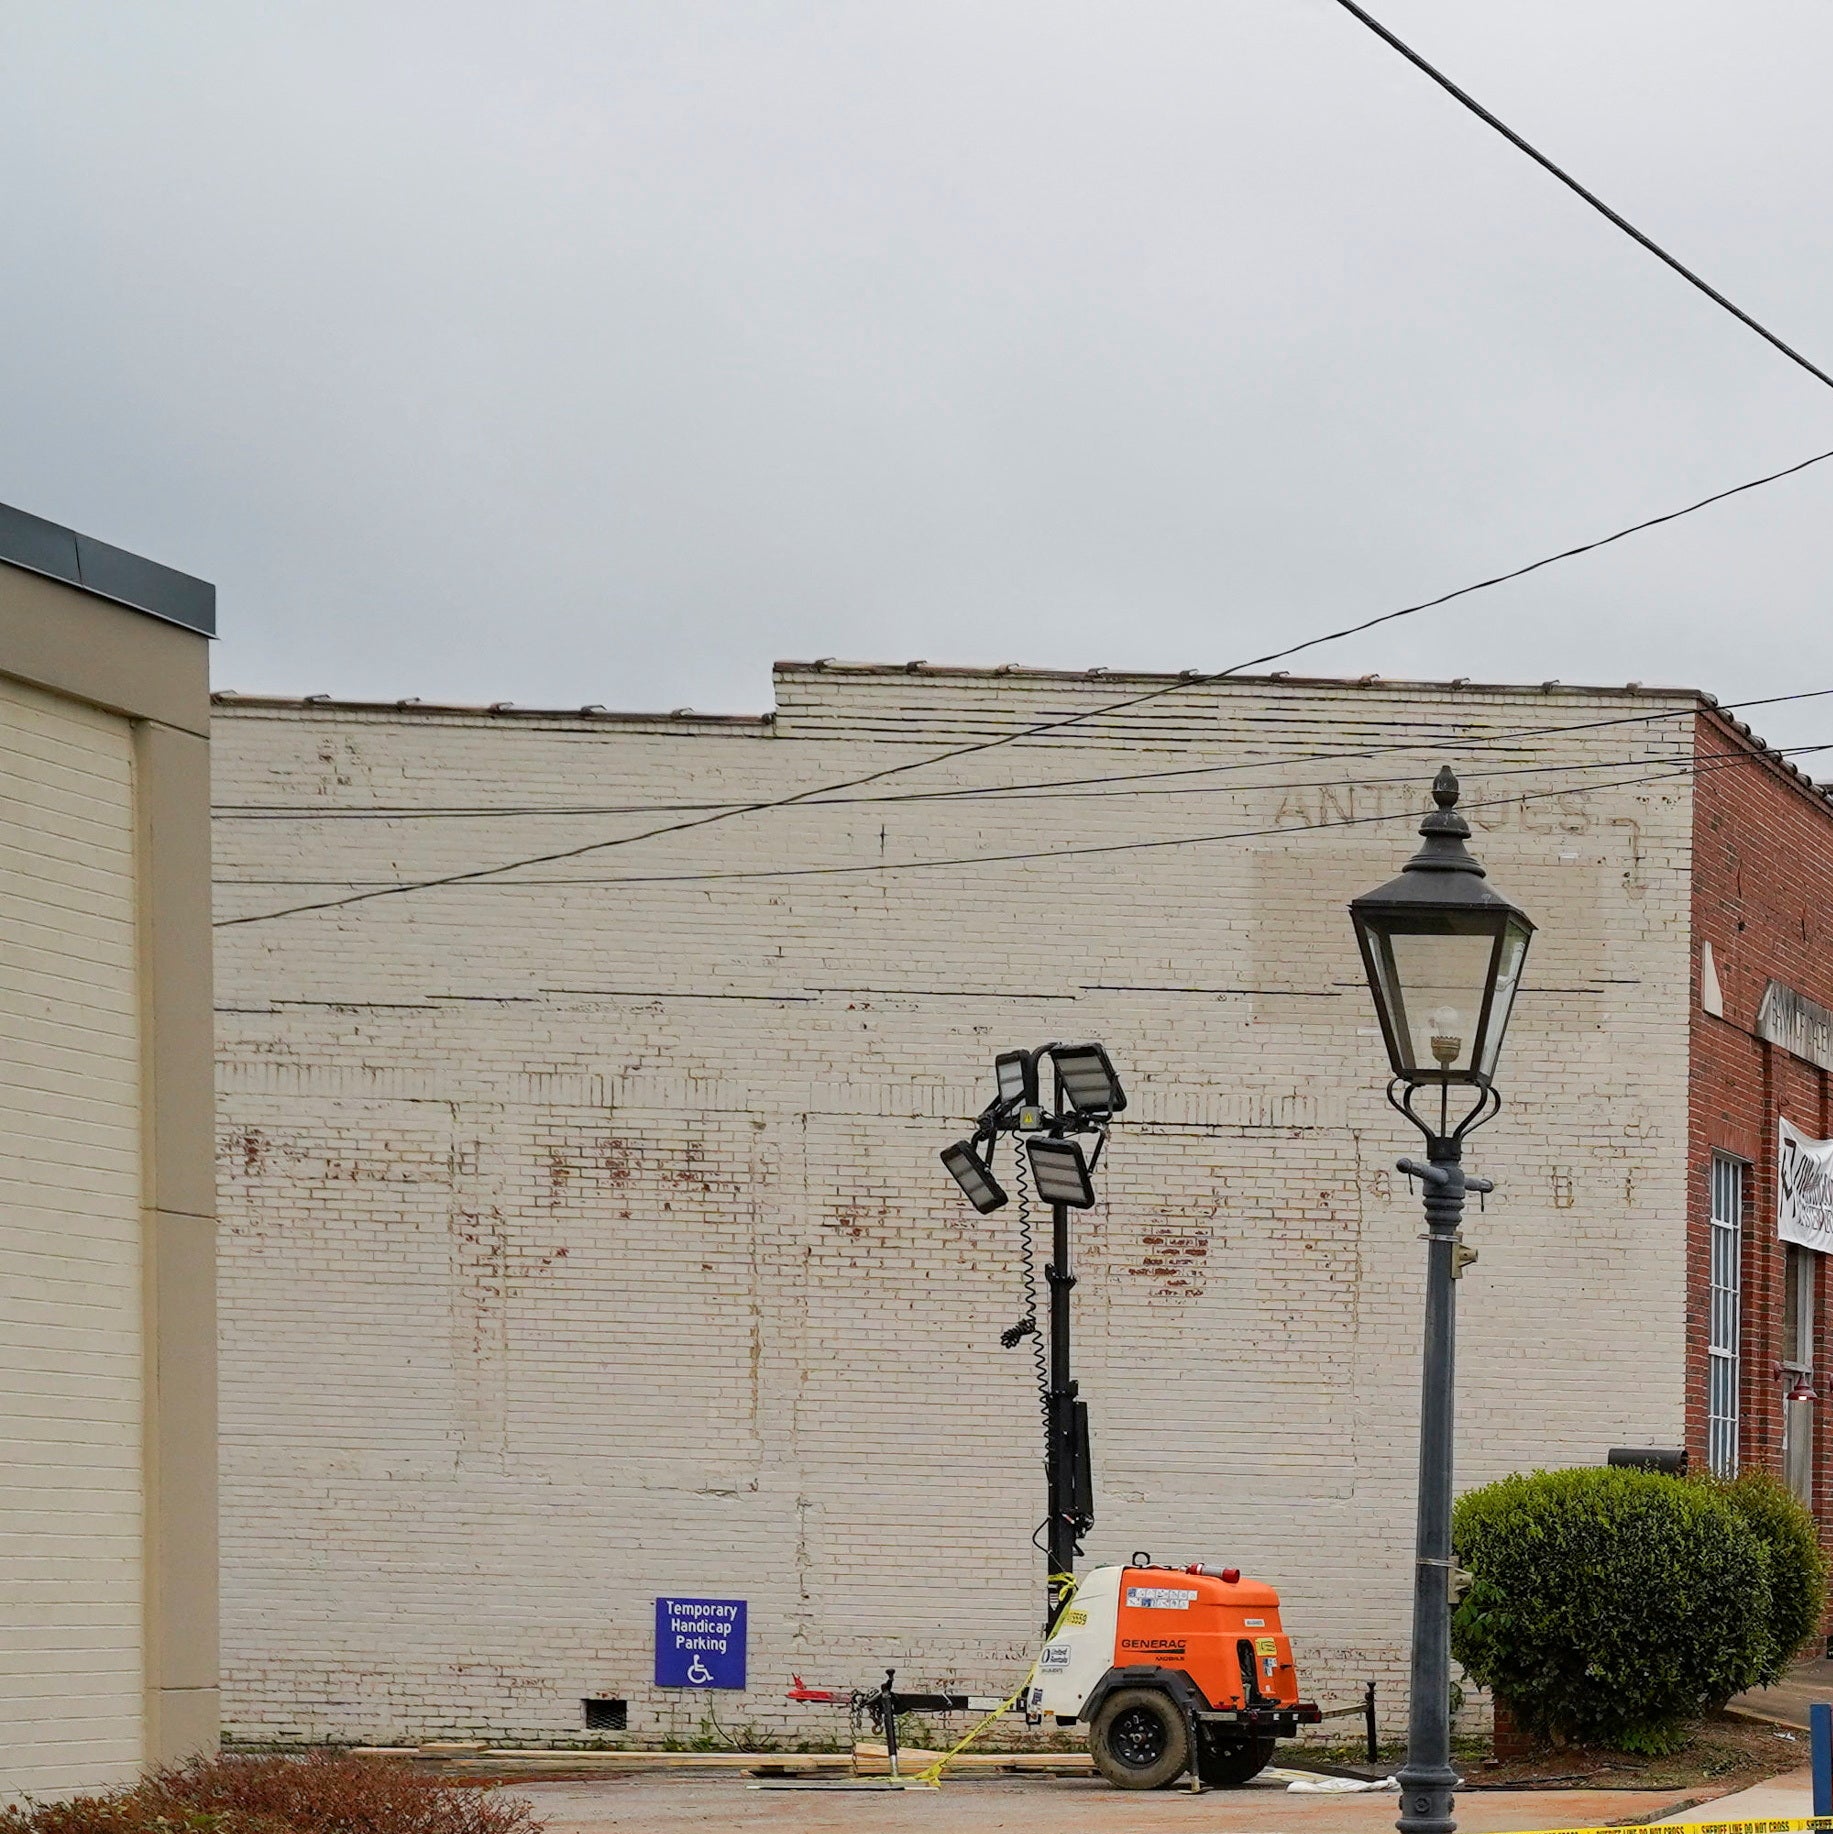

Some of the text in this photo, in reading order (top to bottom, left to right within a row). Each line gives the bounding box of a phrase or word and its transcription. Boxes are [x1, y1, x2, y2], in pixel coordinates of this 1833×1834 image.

[1275, 784, 1592, 834] ANTIUES
[666, 1601, 738, 1621] Temporary
[671, 1618, 732, 1637] Handicap
[676, 1635, 727, 1655] Parking
[1121, 1639, 1186, 1648] GENERAC
[1744, 1822, 1754, 1834] DO
[1754, 1821, 1768, 1834] NOT
[1768, 1820, 1790, 1834] CROSS
